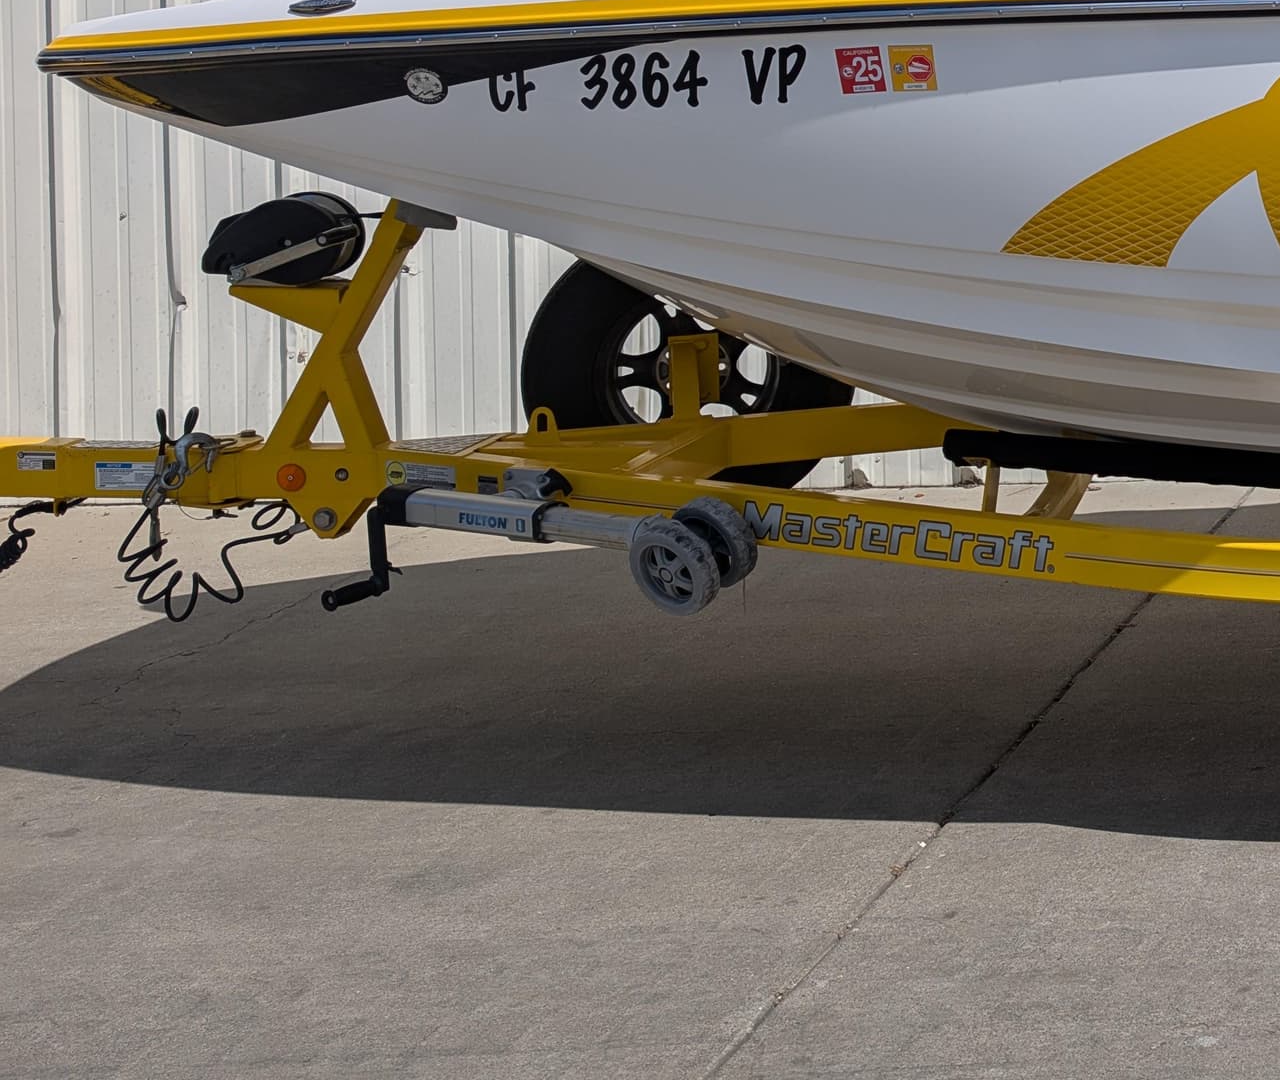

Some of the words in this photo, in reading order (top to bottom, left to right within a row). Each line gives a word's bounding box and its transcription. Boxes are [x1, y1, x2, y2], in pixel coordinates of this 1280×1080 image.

[579, 50, 708, 110] 3864
[741, 44, 806, 104] VP
[852, 55, 883, 82] 25
[458, 512, 508, 530] FULTON
[743, 500, 1055, 573] MasterCraft
